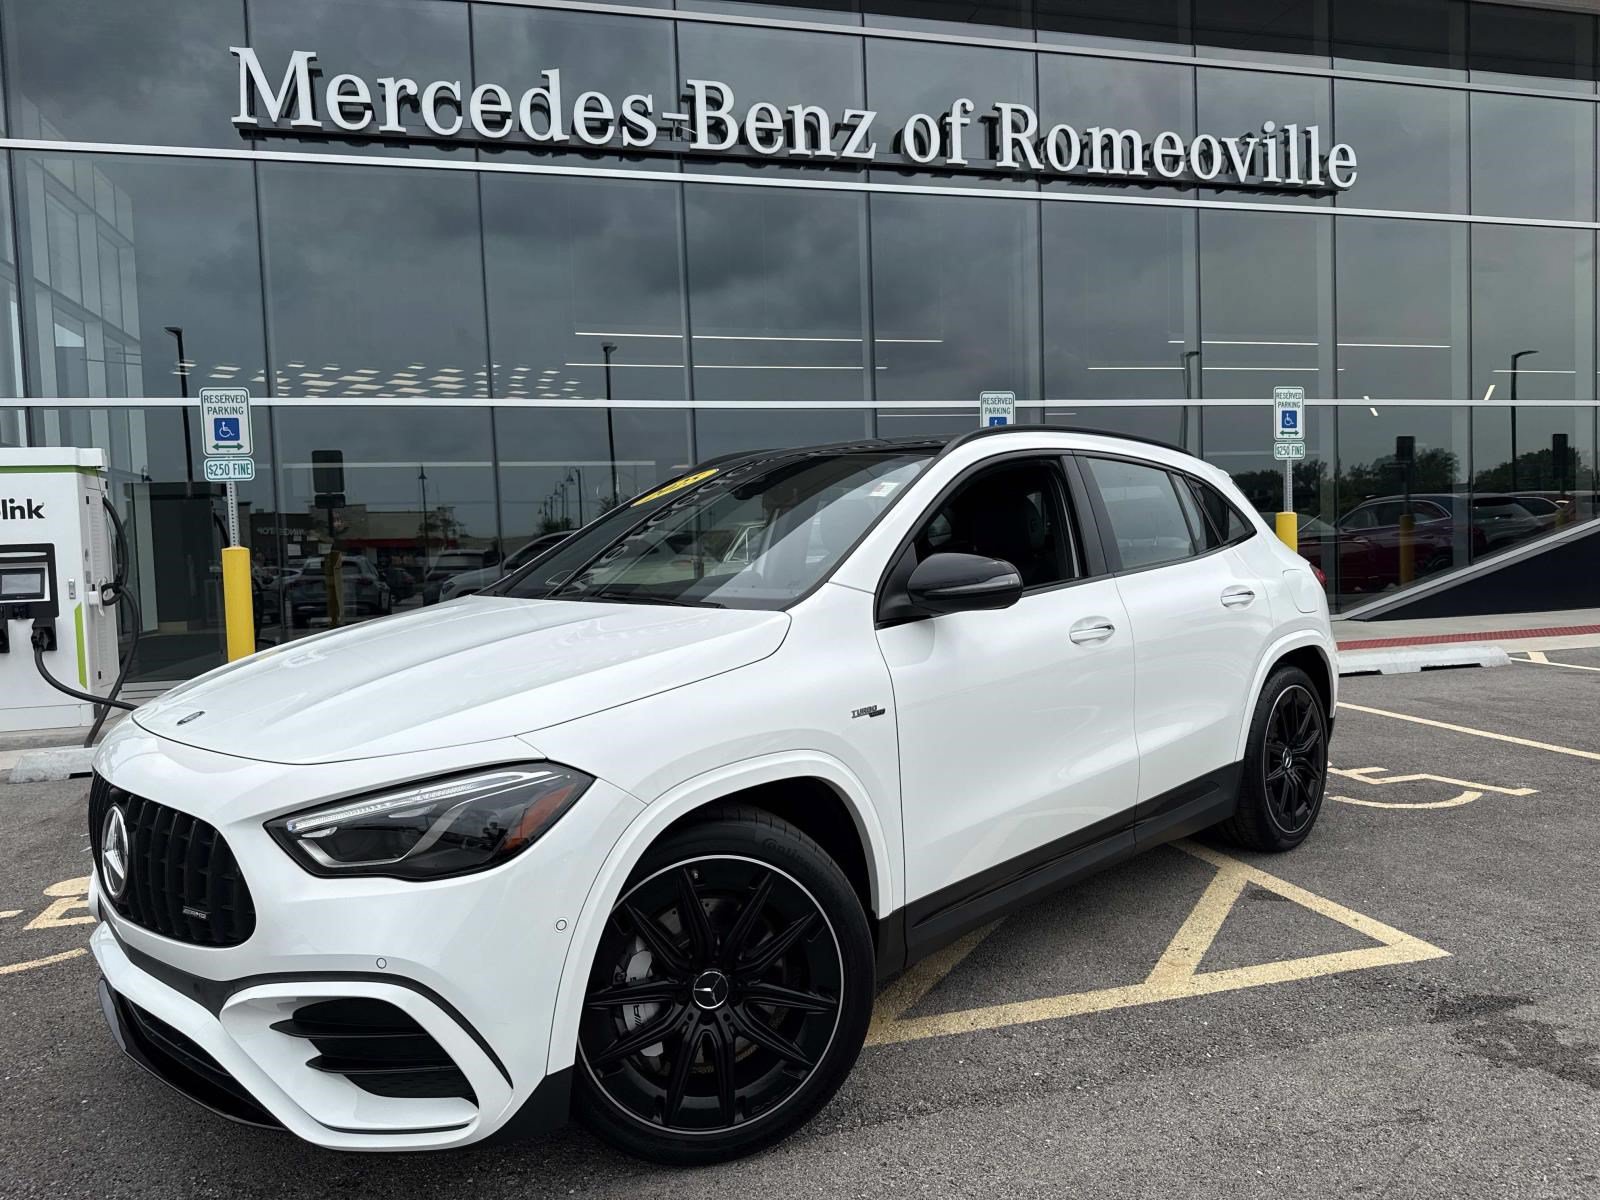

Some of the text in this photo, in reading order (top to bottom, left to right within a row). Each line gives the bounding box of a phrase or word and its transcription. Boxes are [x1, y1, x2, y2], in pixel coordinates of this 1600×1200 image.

[229, 46, 1358, 189] Mercedes-Benz of Romeoville
[203, 394, 246, 404] RESERVED
[982, 397, 1013, 405] RESERVED
[1275, 392, 1302, 400] RESERVED
[1277, 401, 1301, 409] PARKING
[207, 406, 244, 416] PARKING
[984, 406, 1011, 415] PARKING
[1291, 445, 1303, 456] FINE
[208, 462, 251, 476] $250 FINE
[0, 498, 46, 520] link
[851, 704, 878, 719] TURBO
